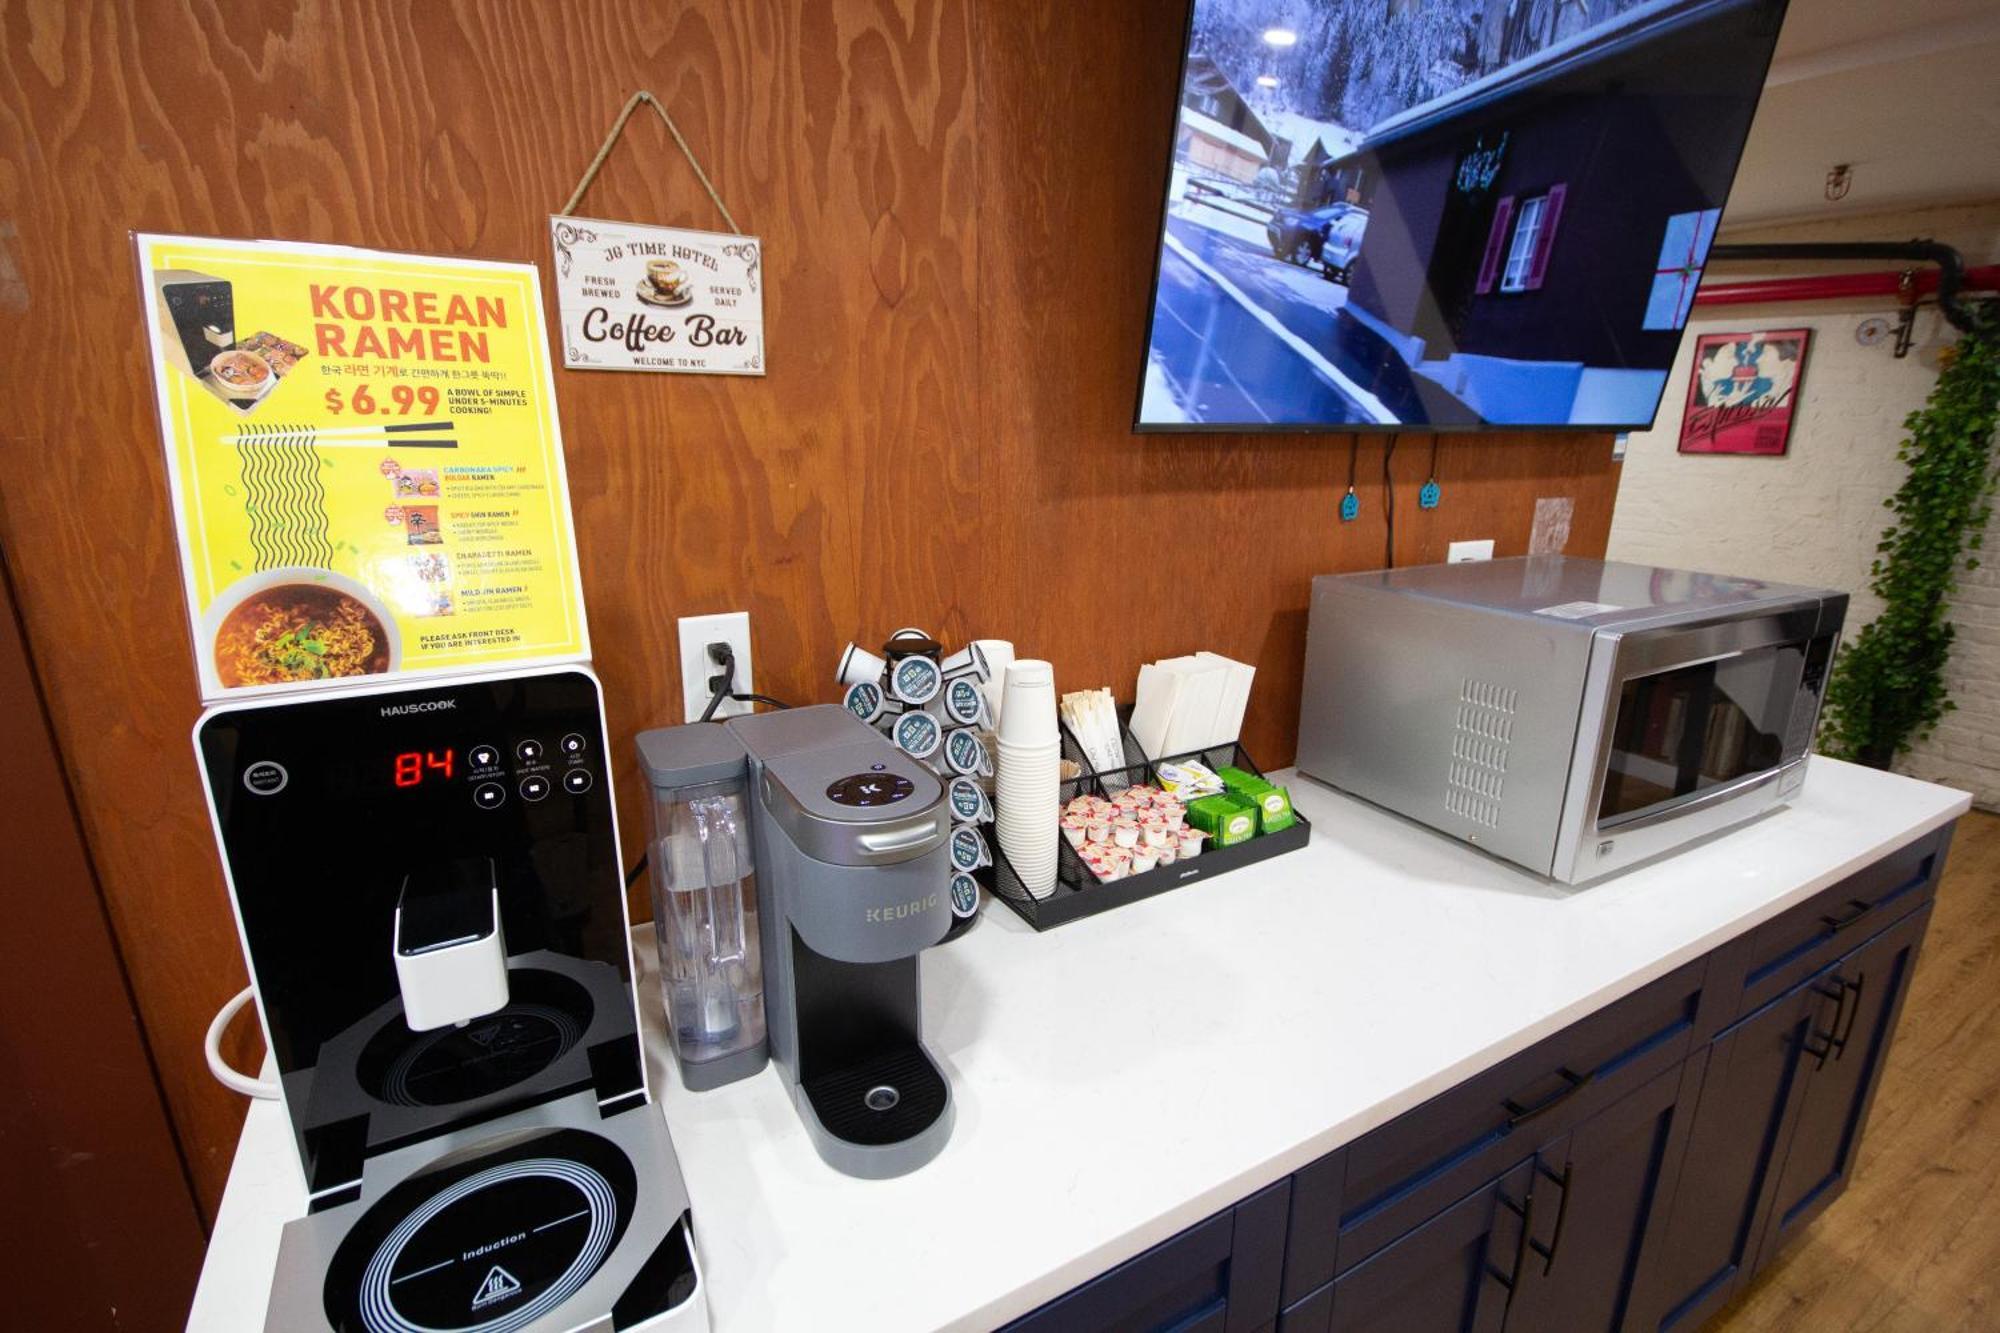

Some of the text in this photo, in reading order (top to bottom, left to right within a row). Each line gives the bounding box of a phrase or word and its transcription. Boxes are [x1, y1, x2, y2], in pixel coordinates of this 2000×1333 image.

[626, 242, 667, 257] TIME
[672, 244, 719, 272] HOTEL
[584, 275, 616, 286] FRESH
[581, 287, 621, 299] BREWED
[709, 285, 742, 296] SERVED
[309, 284, 508, 329] KOREAN
[714, 298, 737, 307] DAILY
[582, 307, 748, 351] Coffee Bar
[315, 323, 490, 363] RAMEN
[633, 357, 707, 368] WELCOME TO NYC
[325, 384, 440, 416] $6.99
[455, 388, 482, 397] BOWL
[483, 389, 494, 397] OF
[448, 397, 478, 405] UNDER
[420, 634, 450, 642] PLEASE
[468, 630, 494, 638] FRONT
[447, 640, 463, 648] ARE
[464, 637, 511, 646] INTERESTED
[380, 699, 457, 717] HAUSCOOK
[394, 748, 455, 788] 84
[866, 894, 938, 923] KEURIG
[462, 1231, 527, 1262] Induction
